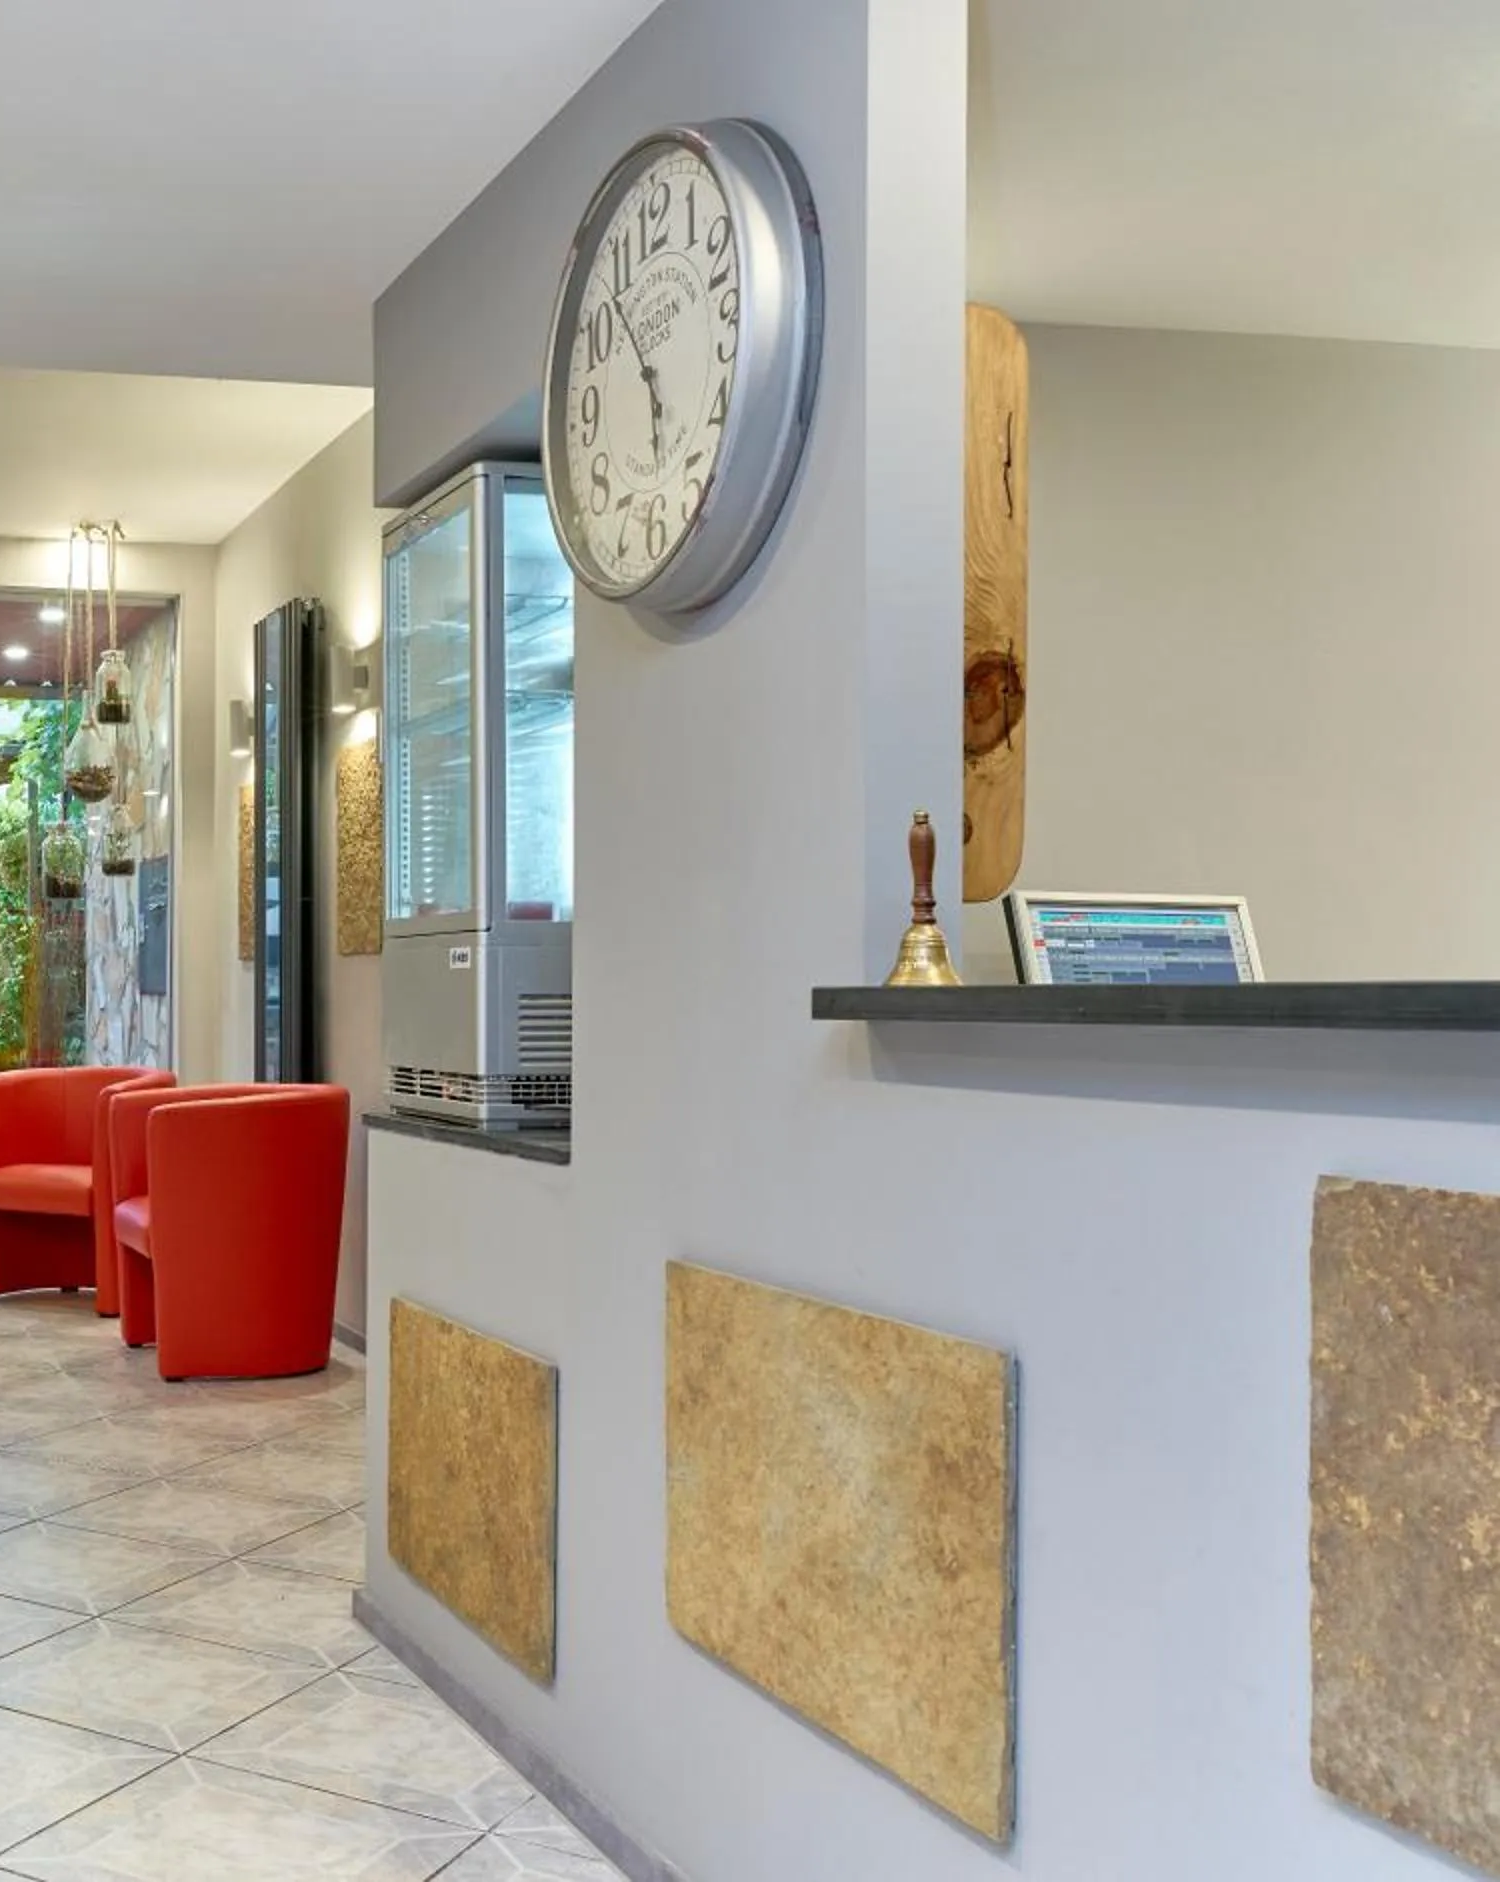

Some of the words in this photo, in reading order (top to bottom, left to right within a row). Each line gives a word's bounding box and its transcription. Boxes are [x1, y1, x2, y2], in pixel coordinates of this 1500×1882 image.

[638, 182, 671, 265] 12
[684, 179, 699, 250] 1
[612, 227, 633, 298] 11
[707, 215, 731, 293] 2
[586, 302, 612, 373] 10
[717, 288, 739, 364] 3
[582, 385, 599, 448] 9
[707, 376, 727, 428] 4
[591, 452, 610, 518] 8
[682, 451, 704, 524] 5
[615, 492, 634, 559] 7
[646, 493, 667, 561] 6
